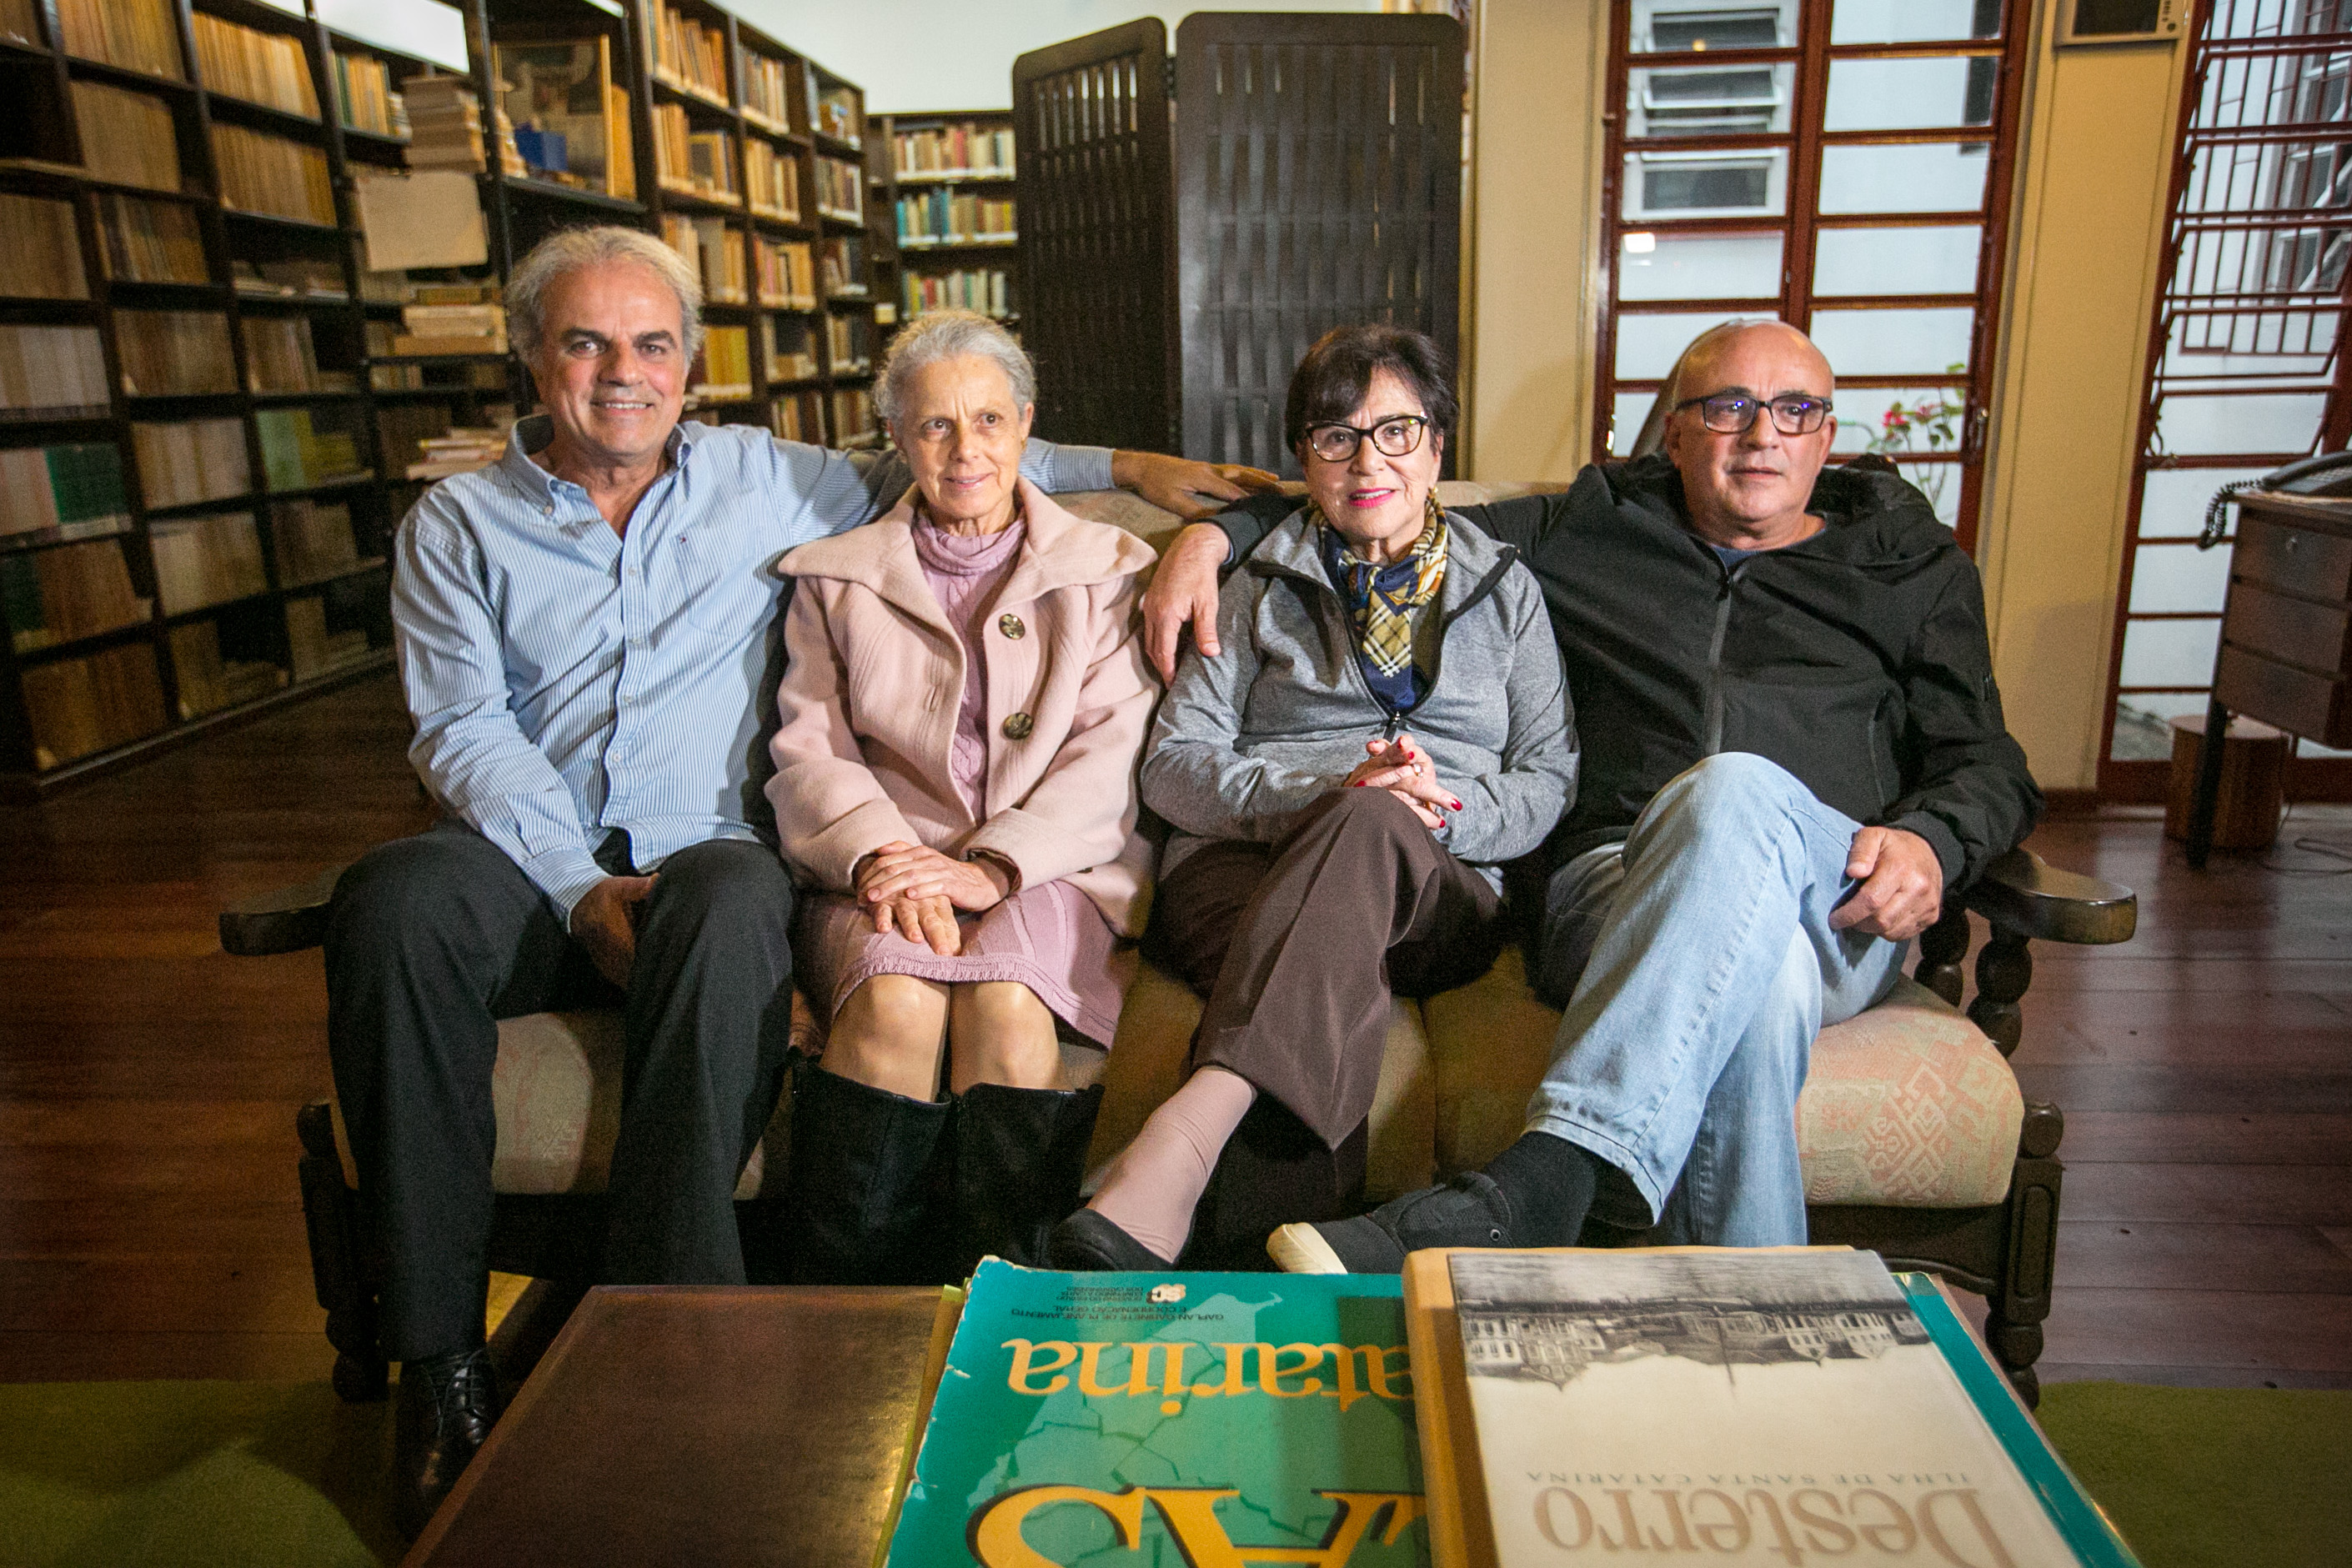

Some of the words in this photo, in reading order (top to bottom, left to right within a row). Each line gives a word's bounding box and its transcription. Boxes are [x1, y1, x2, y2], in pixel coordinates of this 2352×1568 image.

[1527, 1470, 1693, 1485] CATARINA
[1707, 1473, 1816, 1485] SANTA
[1836, 1474, 1875, 1485] DE
[1888, 1471, 1971, 1485] ILHA
[1532, 1486, 2019, 1568] Desterro
